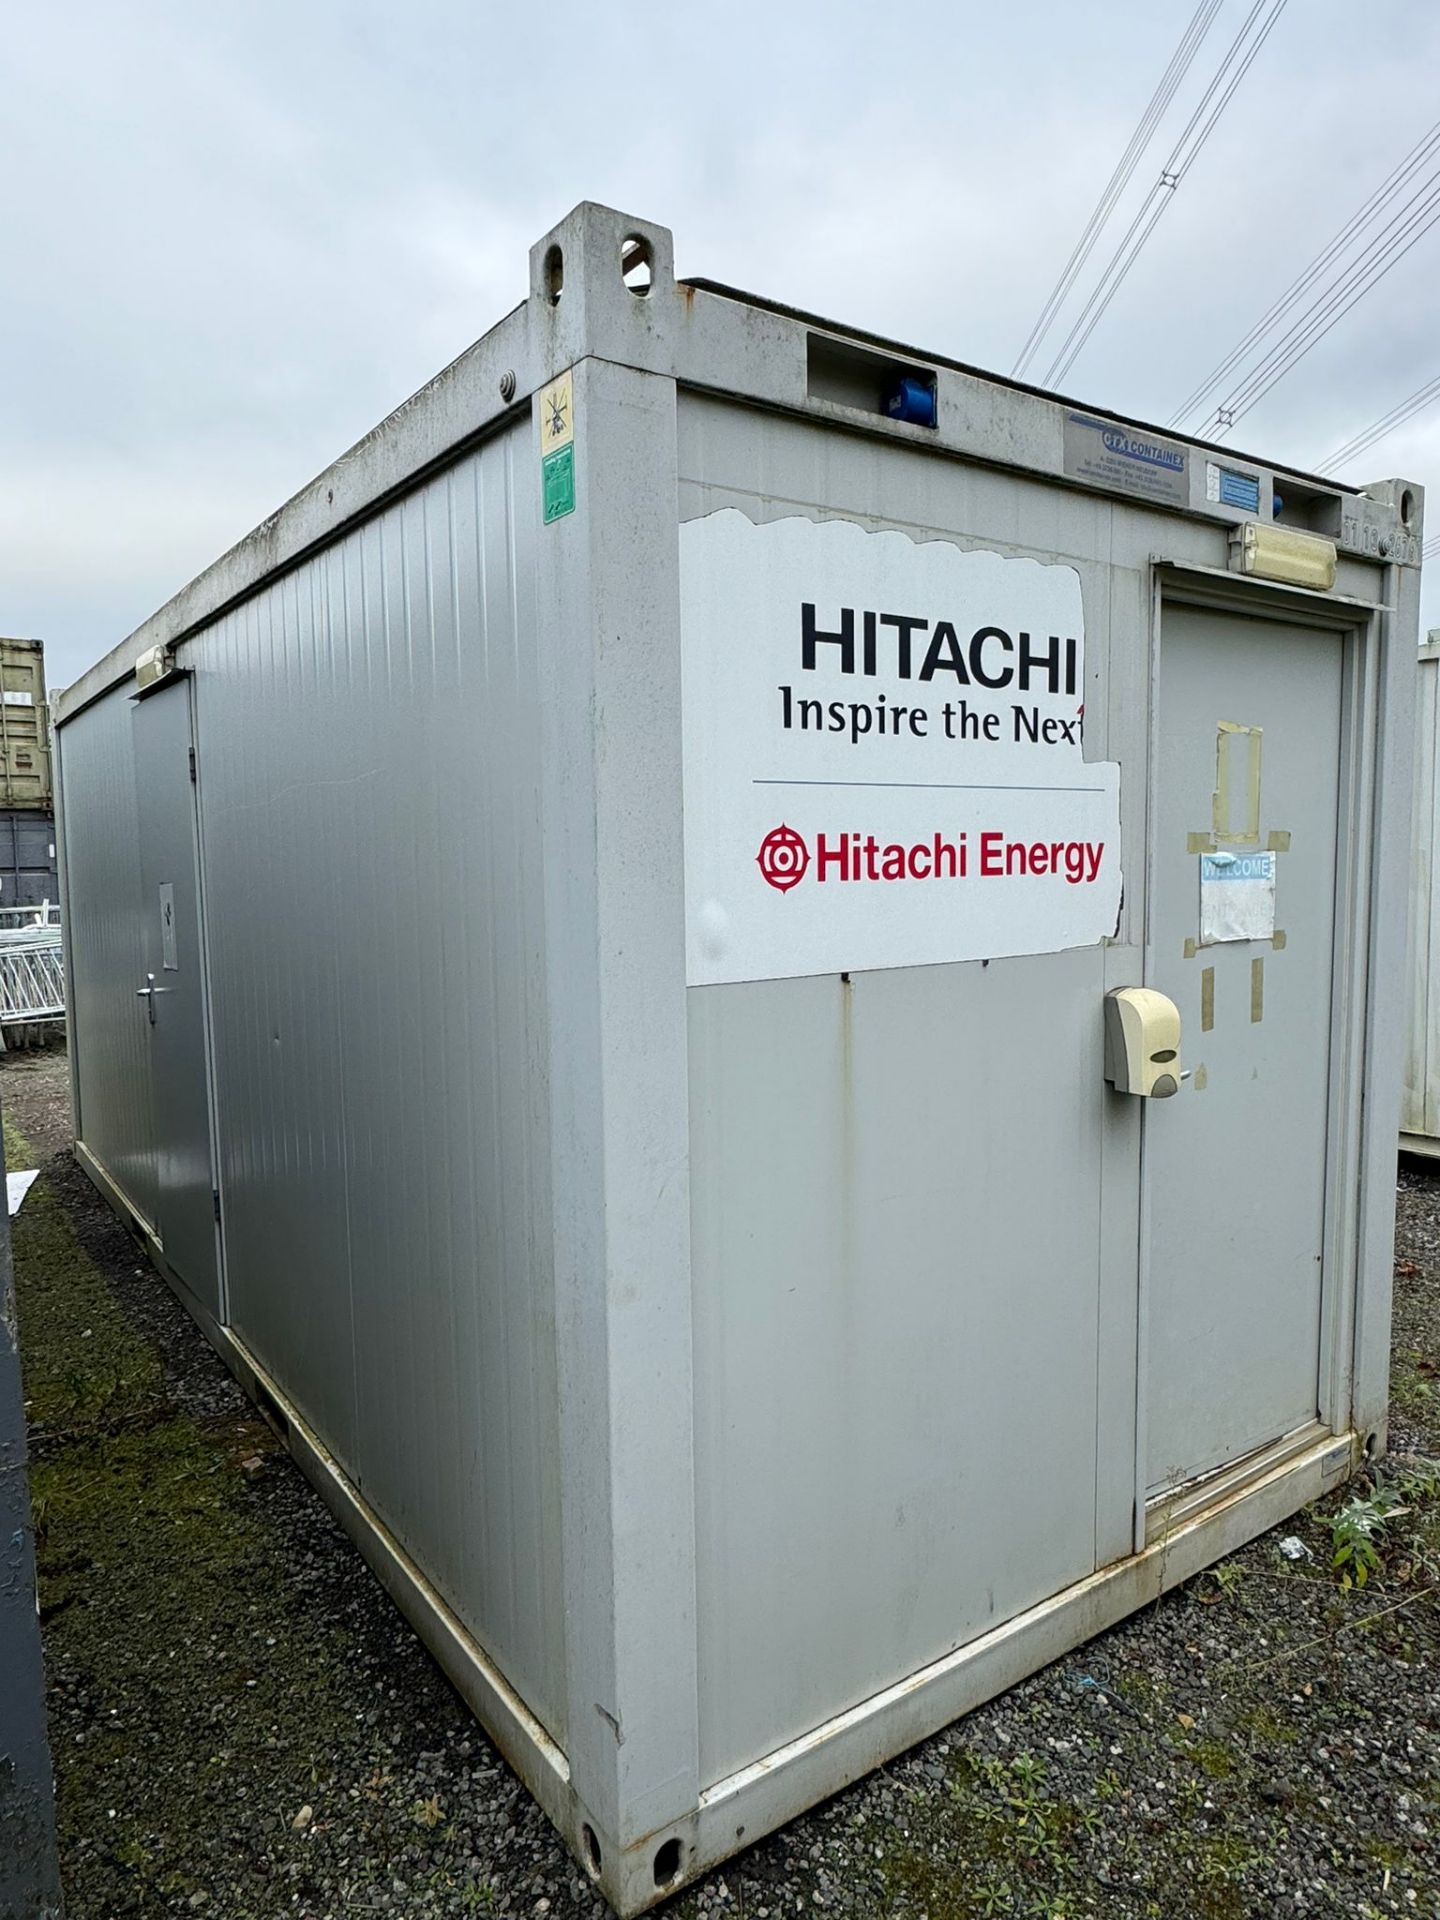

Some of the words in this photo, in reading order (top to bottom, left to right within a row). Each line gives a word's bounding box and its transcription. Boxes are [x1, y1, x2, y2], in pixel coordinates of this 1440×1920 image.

[1103, 432, 1127, 452] CTX
[1130, 441, 1185, 467] CONTAINEX
[801, 602, 1077, 696] HITACHI
[778, 685, 929, 744] Inspire
[941, 700, 1001, 741] the
[816, 832, 968, 883] Hitachi
[980, 831, 1106, 885] Energy
